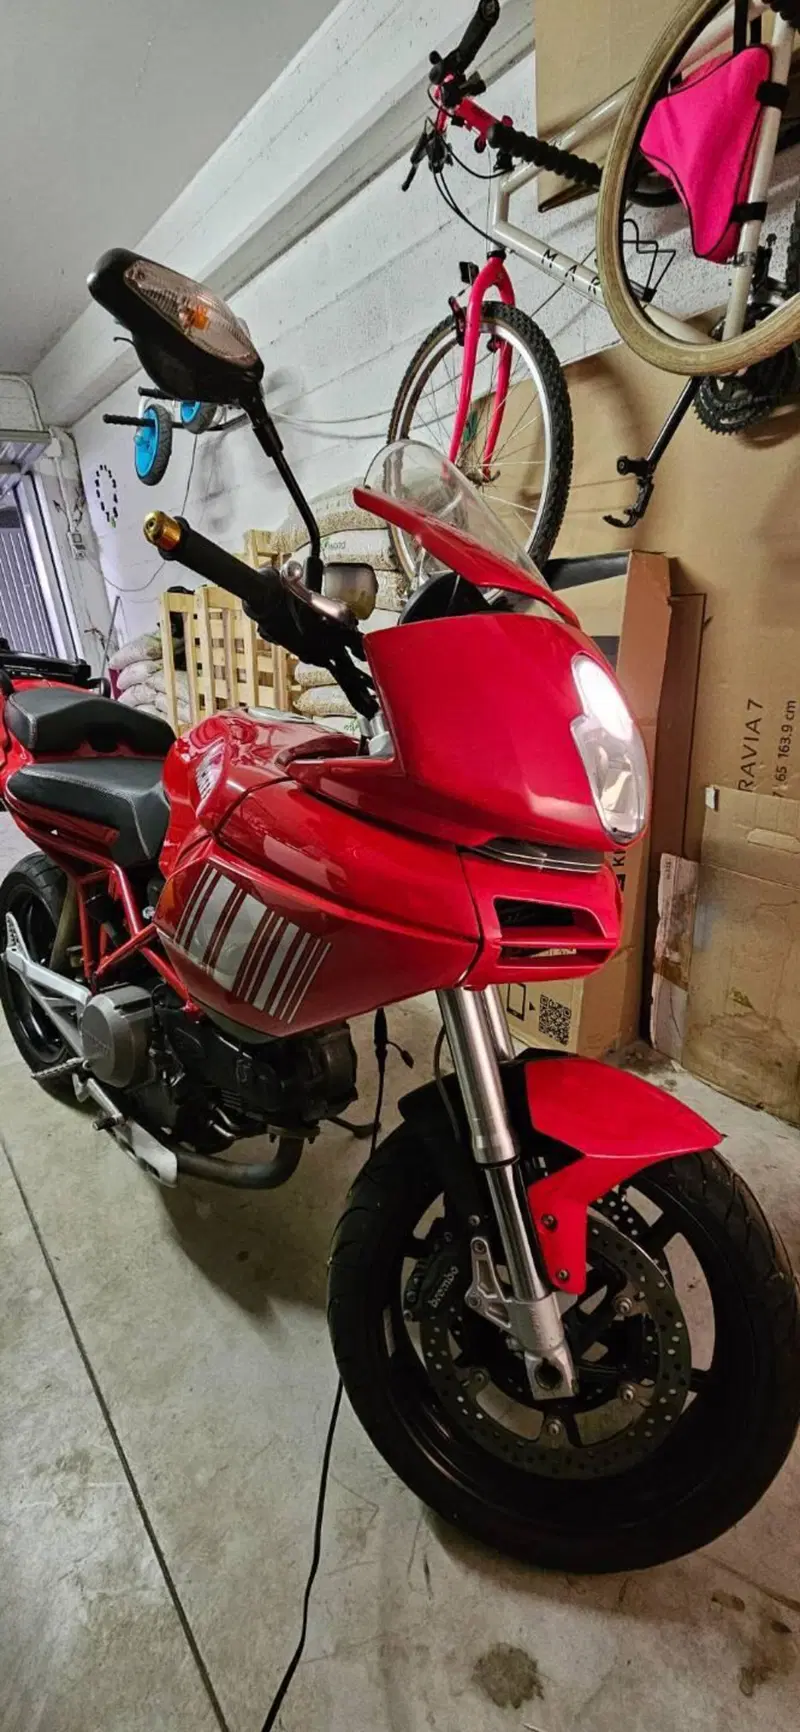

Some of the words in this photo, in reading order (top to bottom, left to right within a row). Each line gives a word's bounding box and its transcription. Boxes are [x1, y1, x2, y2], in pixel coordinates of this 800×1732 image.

[747, 698, 763, 711] 7
[786, 700, 797, 720] cm
[737, 718, 762, 792] RAVIA
[778, 724, 793, 759] 163.9
[775, 765, 787, 782] 65
[427, 1265, 459, 1308] brembo
